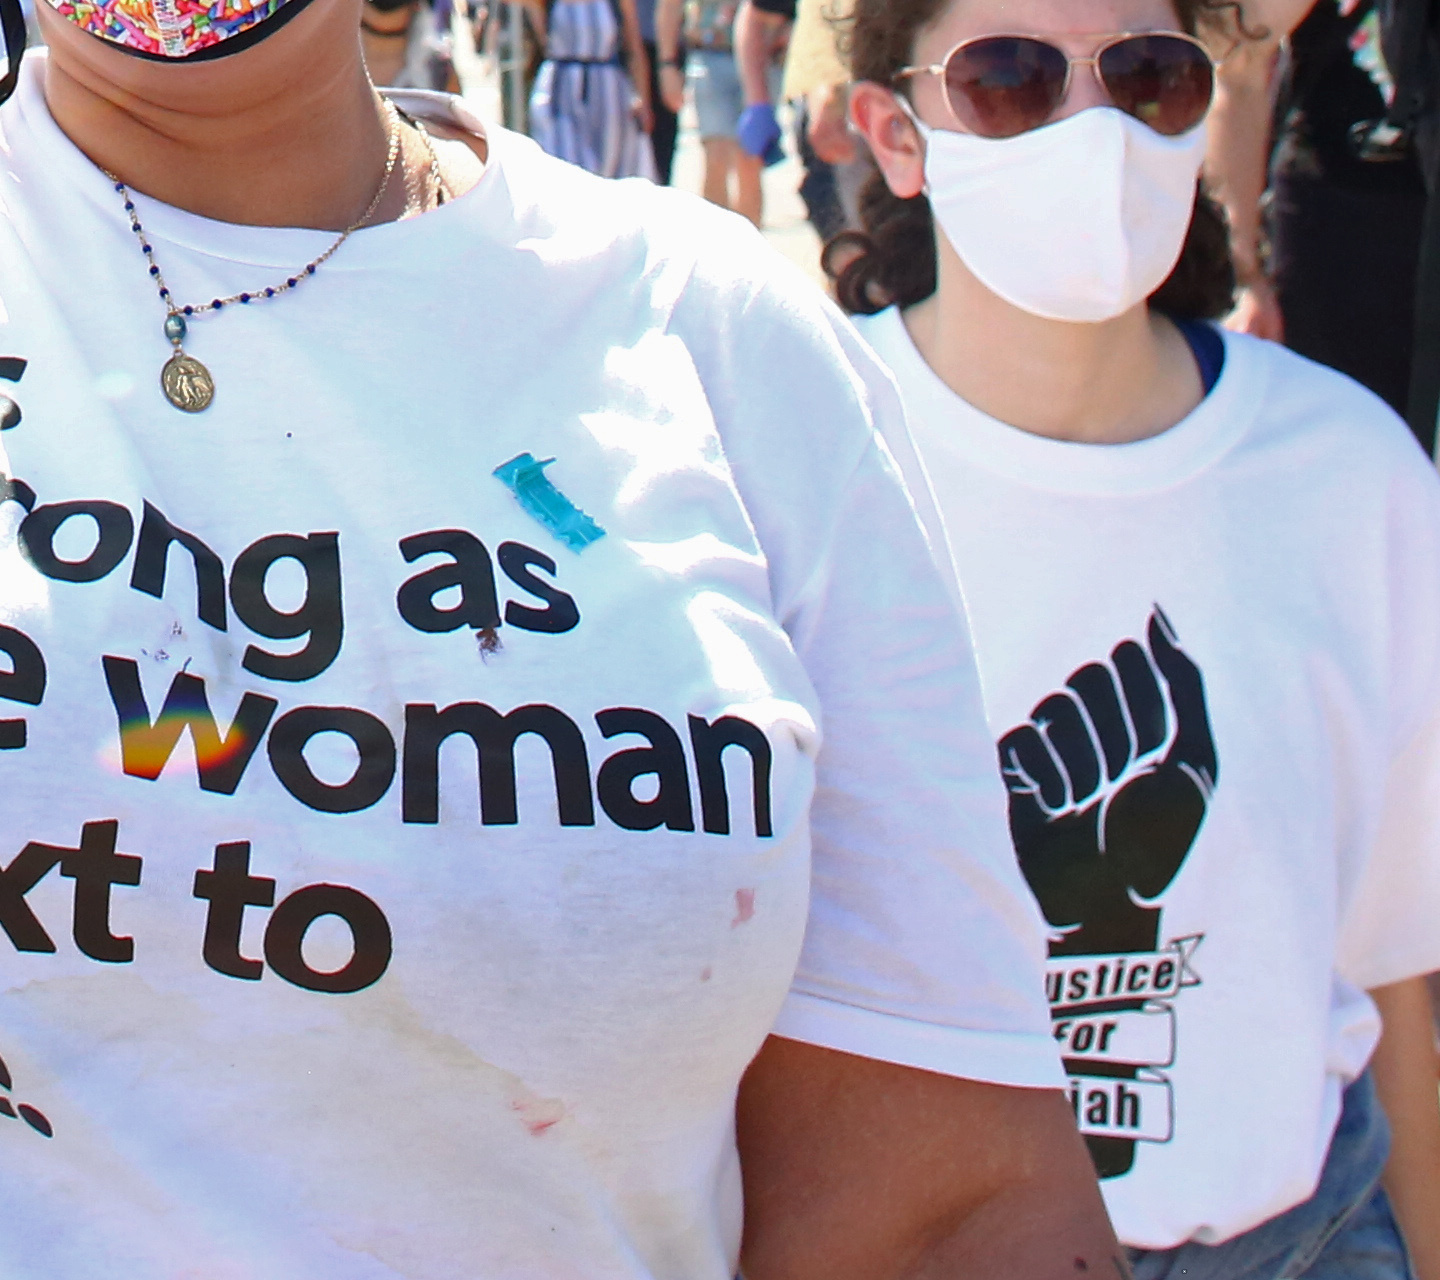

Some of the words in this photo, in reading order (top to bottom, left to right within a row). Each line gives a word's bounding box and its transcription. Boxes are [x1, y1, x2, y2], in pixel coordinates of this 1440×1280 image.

[395, 528, 581, 635] as
[100, 653, 774, 838] woman
[192, 840, 394, 995] to
[1045, 957, 1176, 1003] ustice
